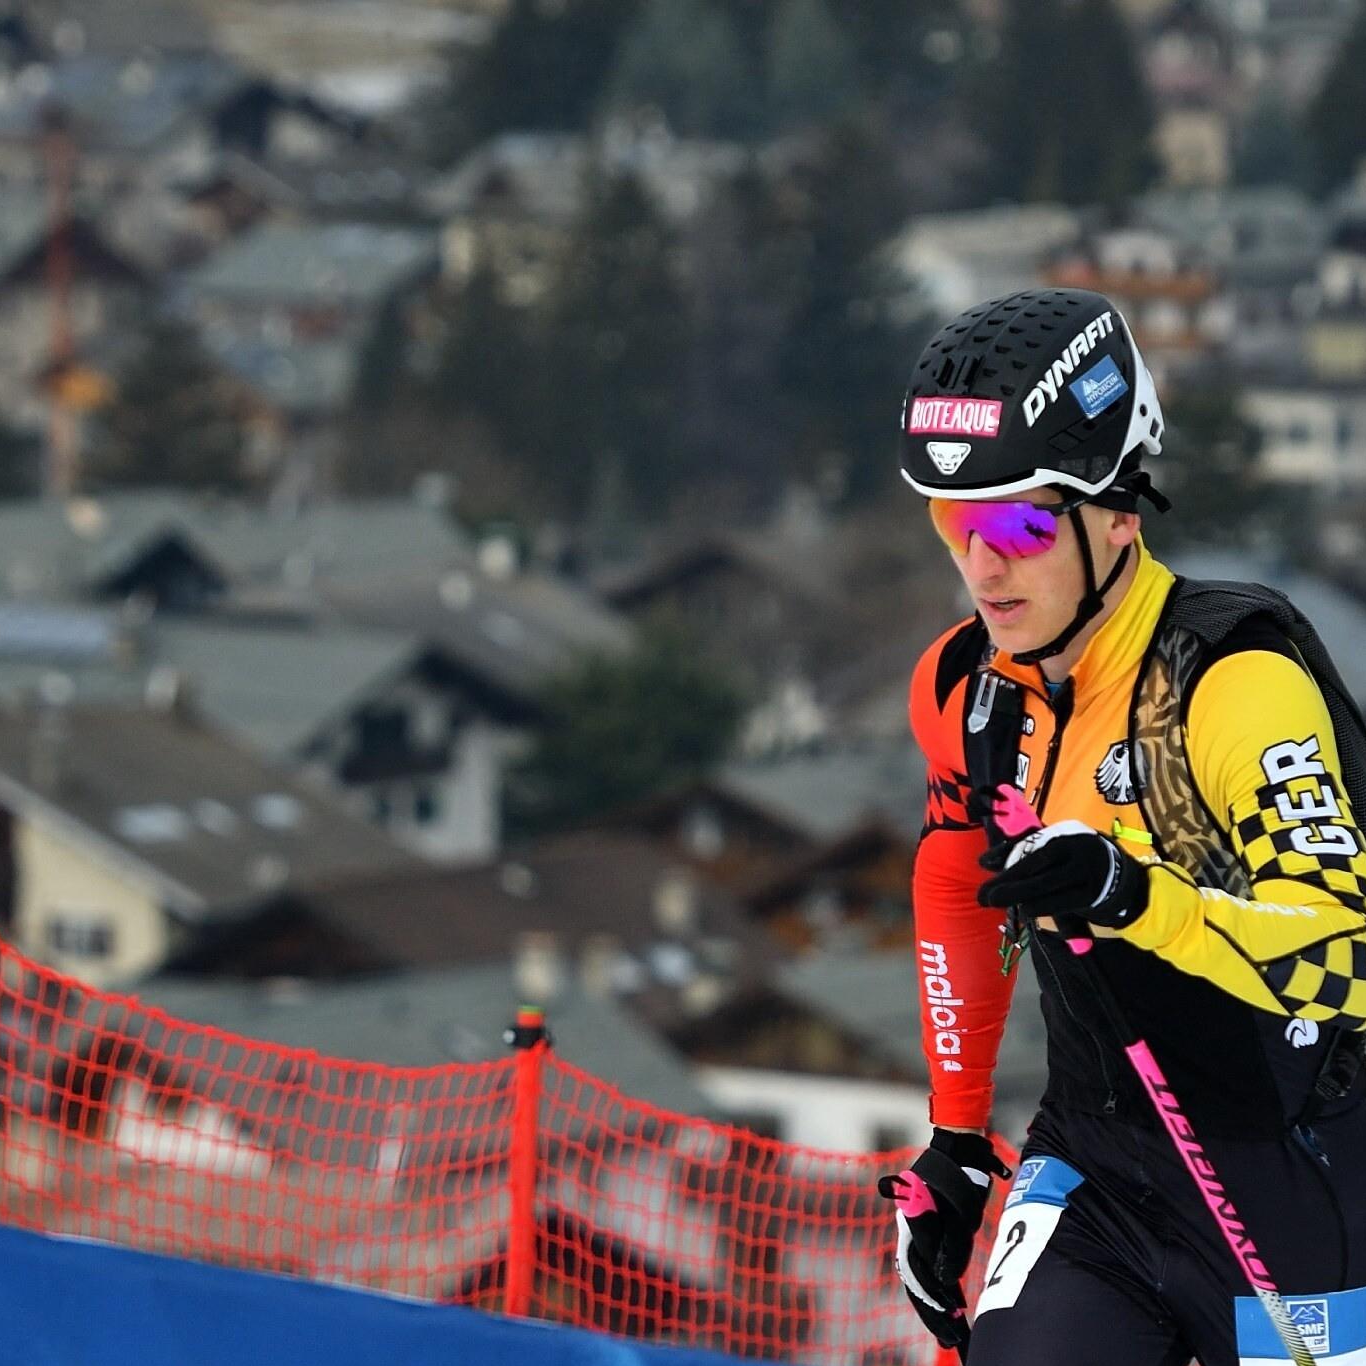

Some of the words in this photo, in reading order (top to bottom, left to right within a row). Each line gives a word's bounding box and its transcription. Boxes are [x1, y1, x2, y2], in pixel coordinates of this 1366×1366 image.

[1022, 311, 1114, 428] DYNAFIT
[910, 401, 999, 434] BIOTEAQUE
[1260, 736, 1360, 857] GER
[1296, 1323, 1326, 1336] SMF
